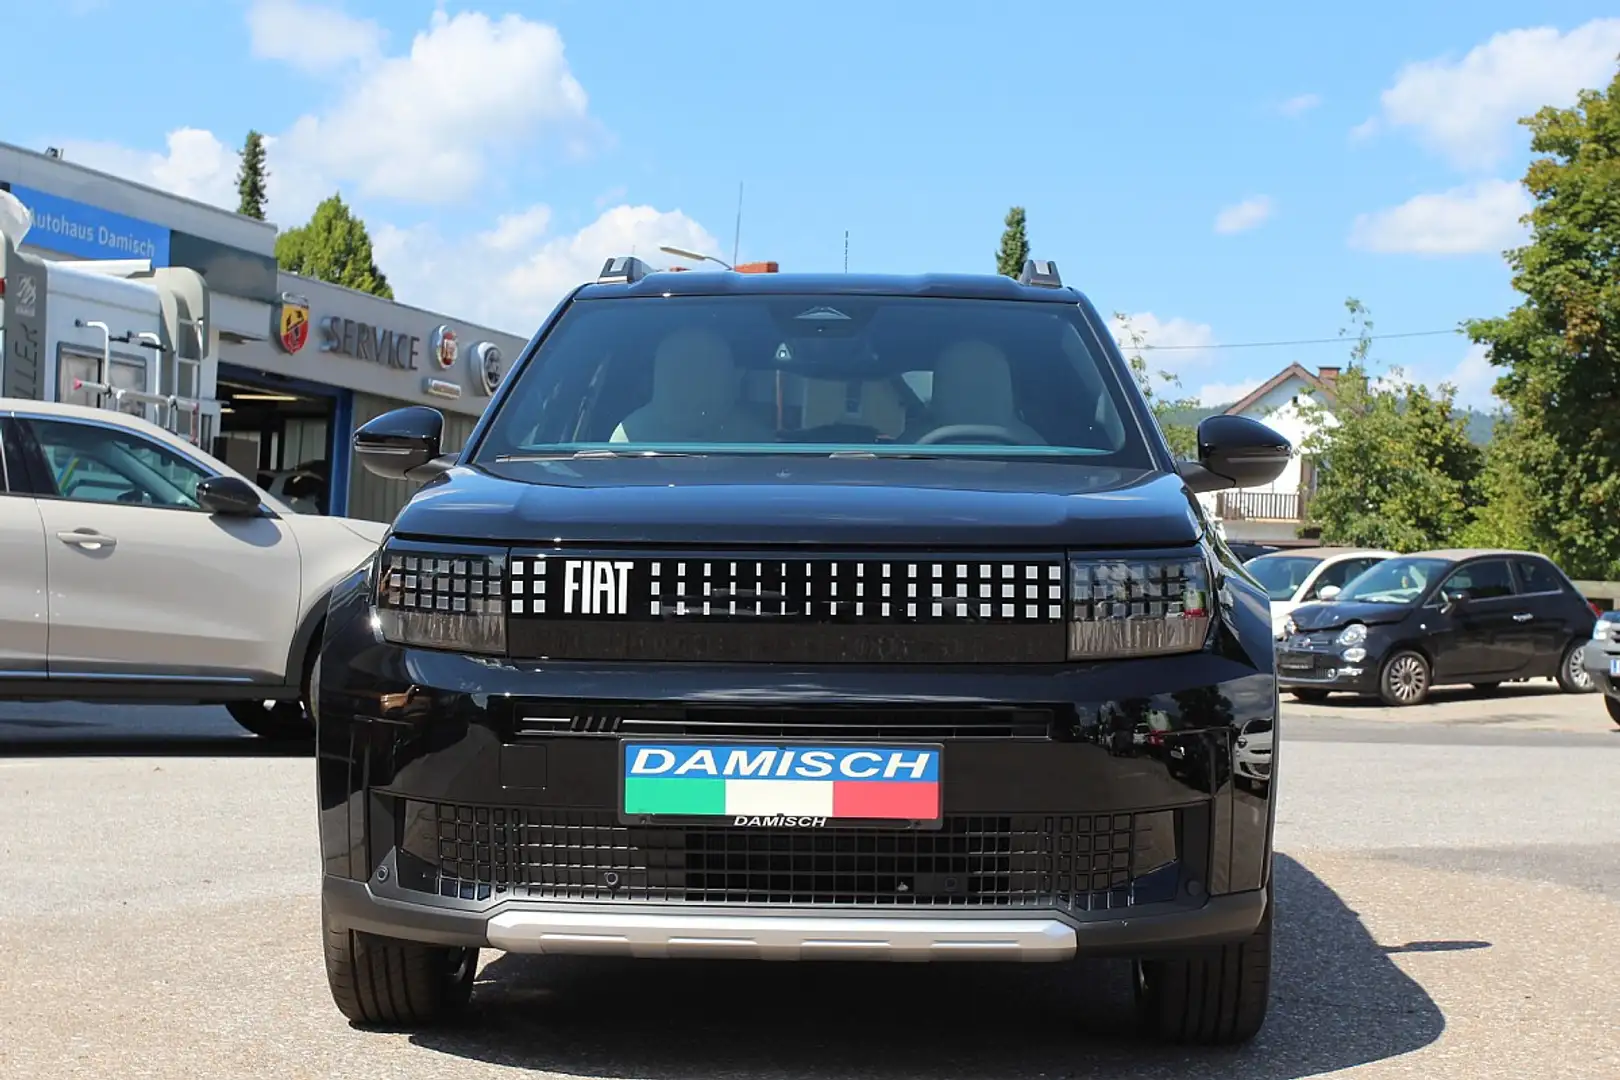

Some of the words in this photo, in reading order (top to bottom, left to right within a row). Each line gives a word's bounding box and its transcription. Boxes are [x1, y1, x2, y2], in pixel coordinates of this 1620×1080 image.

[98, 225, 155, 258] Damisch
[321, 315, 420, 371] SERVICE
[564, 560, 634, 615] FIAT
[630, 748, 930, 778] DAMISCH
[733, 815, 827, 828] DAMISCH
